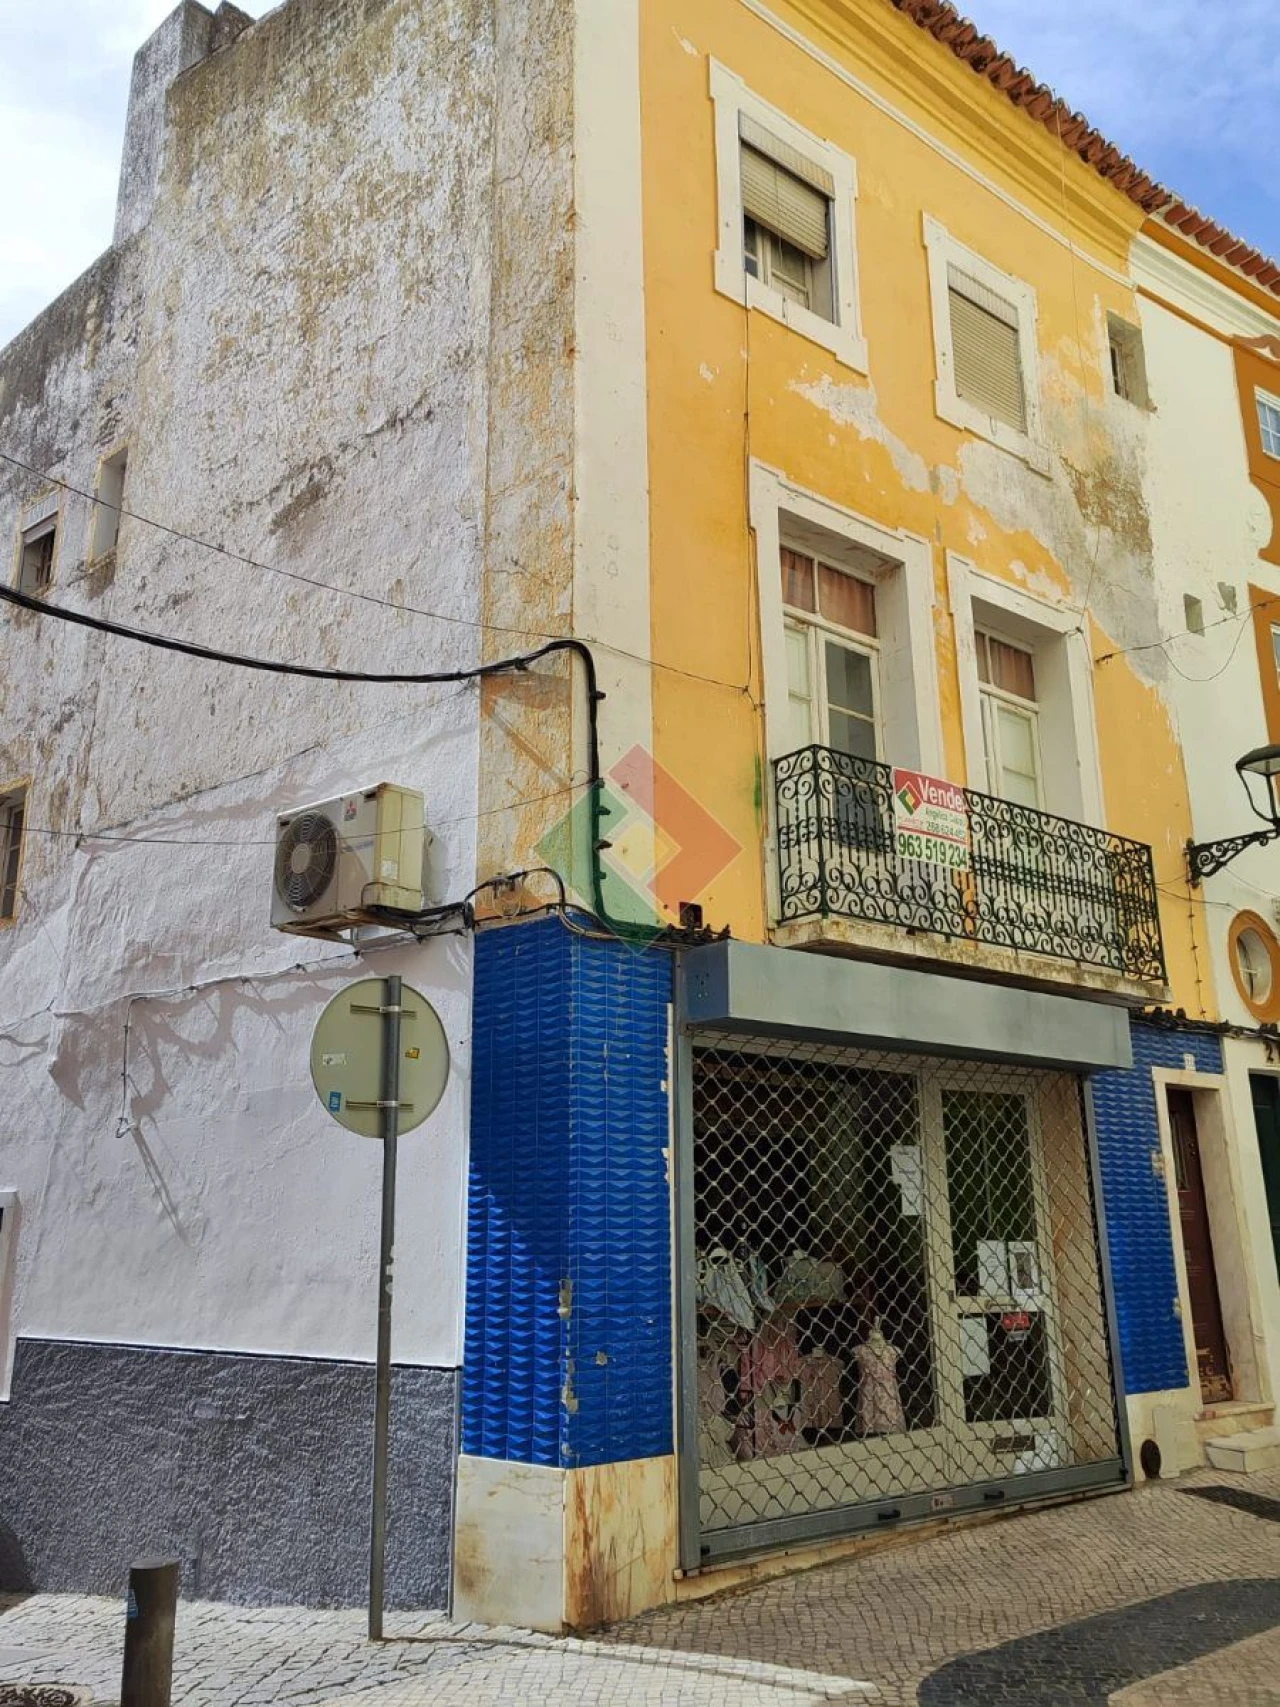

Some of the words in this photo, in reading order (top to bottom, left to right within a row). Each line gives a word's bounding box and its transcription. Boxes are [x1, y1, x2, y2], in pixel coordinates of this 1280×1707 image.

[917, 777, 963, 812] Vende
[898, 832, 923, 859] 963
[925, 838, 947, 864] 519
[948, 844, 968, 867] 234
